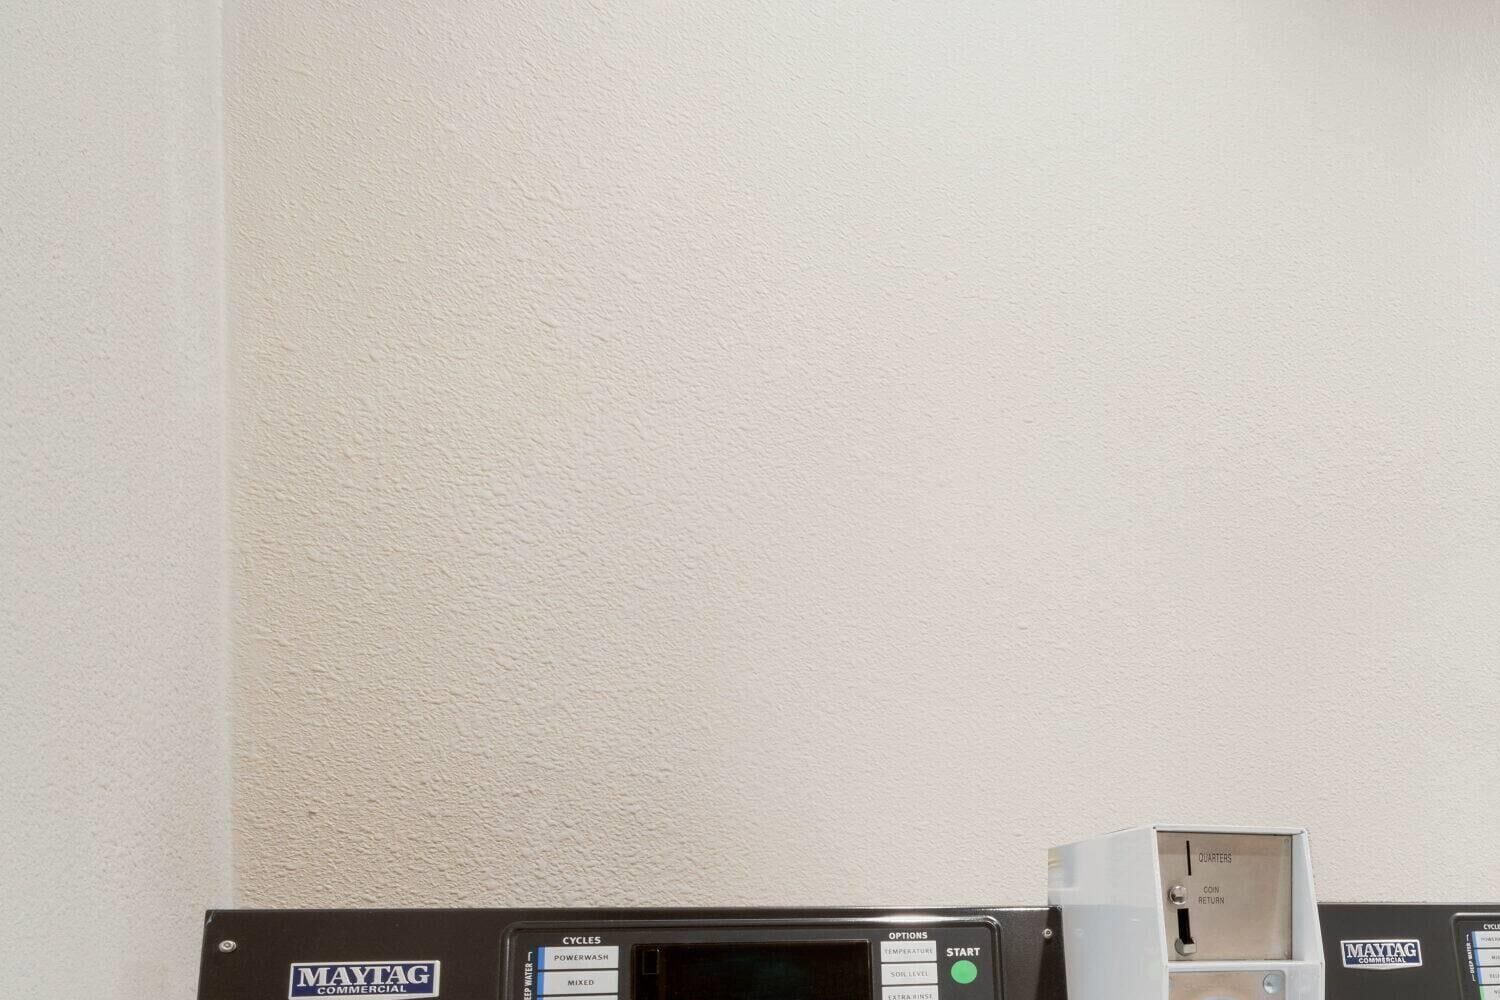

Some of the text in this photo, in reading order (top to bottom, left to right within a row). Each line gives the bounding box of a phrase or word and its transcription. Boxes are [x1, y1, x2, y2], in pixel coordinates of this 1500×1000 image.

[1199, 853, 1232, 863] QUARTERS
[1198, 896, 1225, 904] RETURN
[562, 936, 602, 945] CYCLES
[888, 932, 928, 940] OPTIONS
[946, 947, 981, 957] START
[1346, 943, 1417, 959] MAYTAG
[296, 965, 430, 987] MAYTAG
[524, 963, 533, 987] WATER
[317, 985, 407, 995] COMMERCIAL
